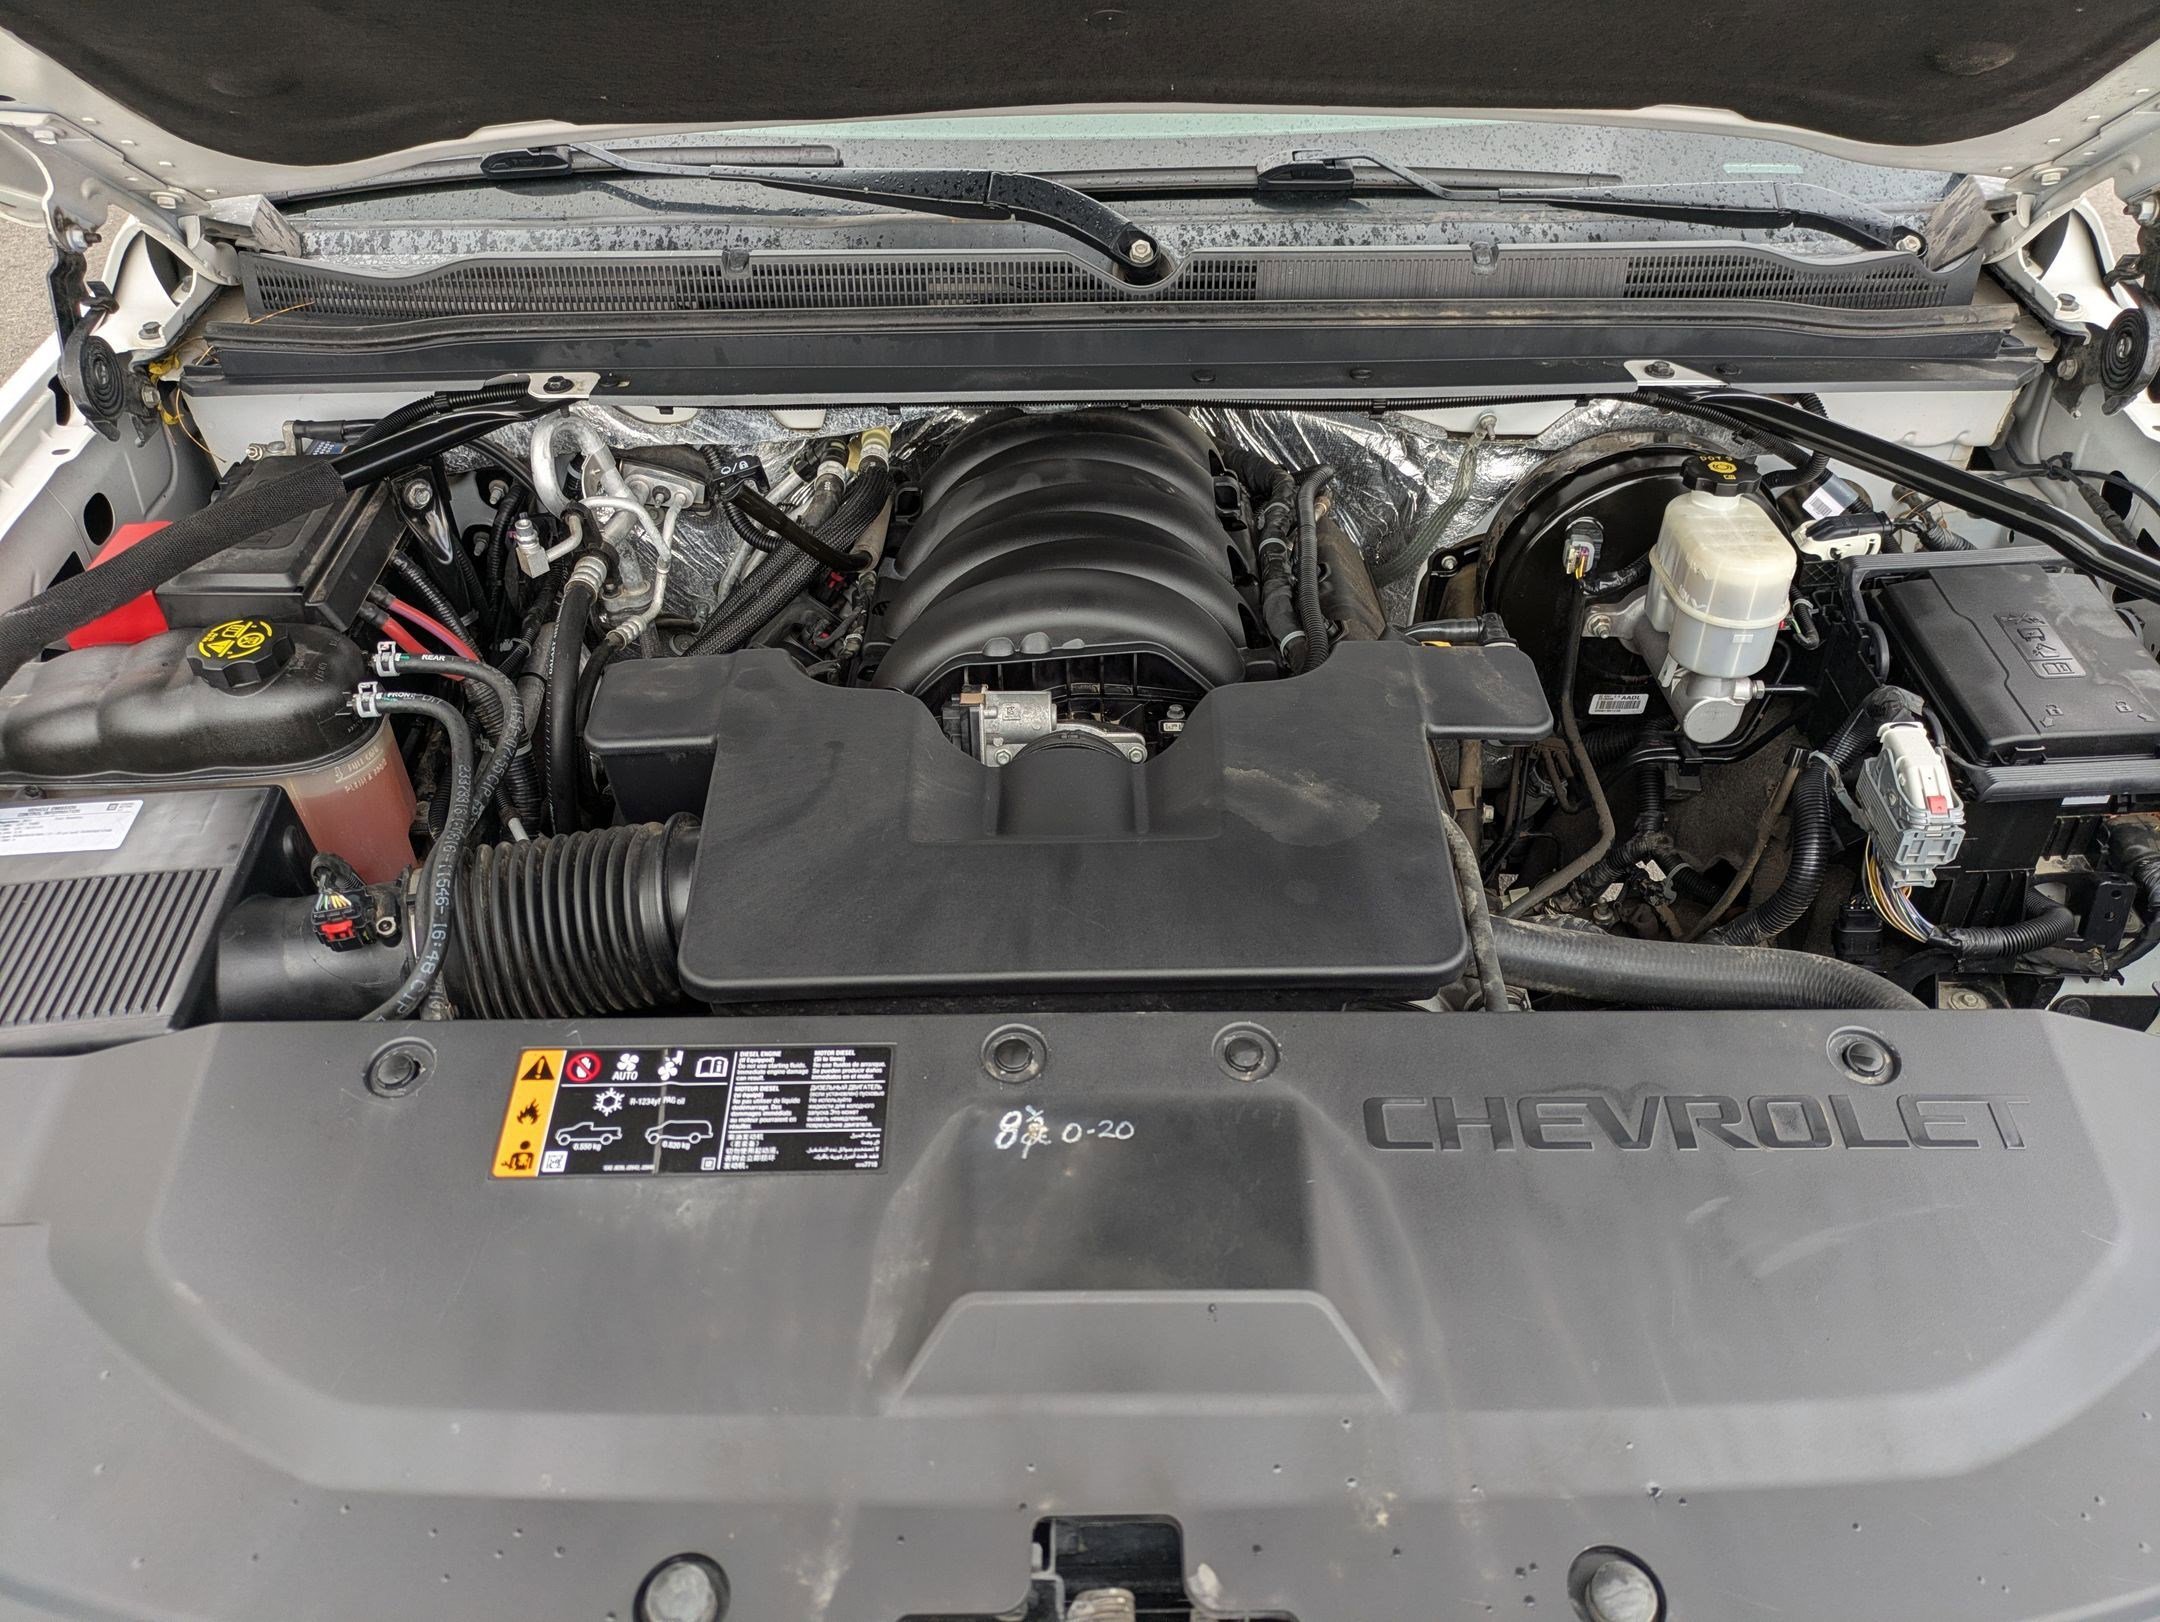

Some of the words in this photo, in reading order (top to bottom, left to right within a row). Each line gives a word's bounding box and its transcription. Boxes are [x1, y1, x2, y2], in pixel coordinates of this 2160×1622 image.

[421, 654, 446, 662] REAR
[548, 641, 557, 675] GALAXY
[420, 923, 448, 975] 16:48
[612, 1071, 638, 1080] AUTO
[662, 1096, 676, 1104] PAG
[1061, 1120, 1135, 1143] 0-20
[1363, 1094, 2031, 1152] CHEVROLET
